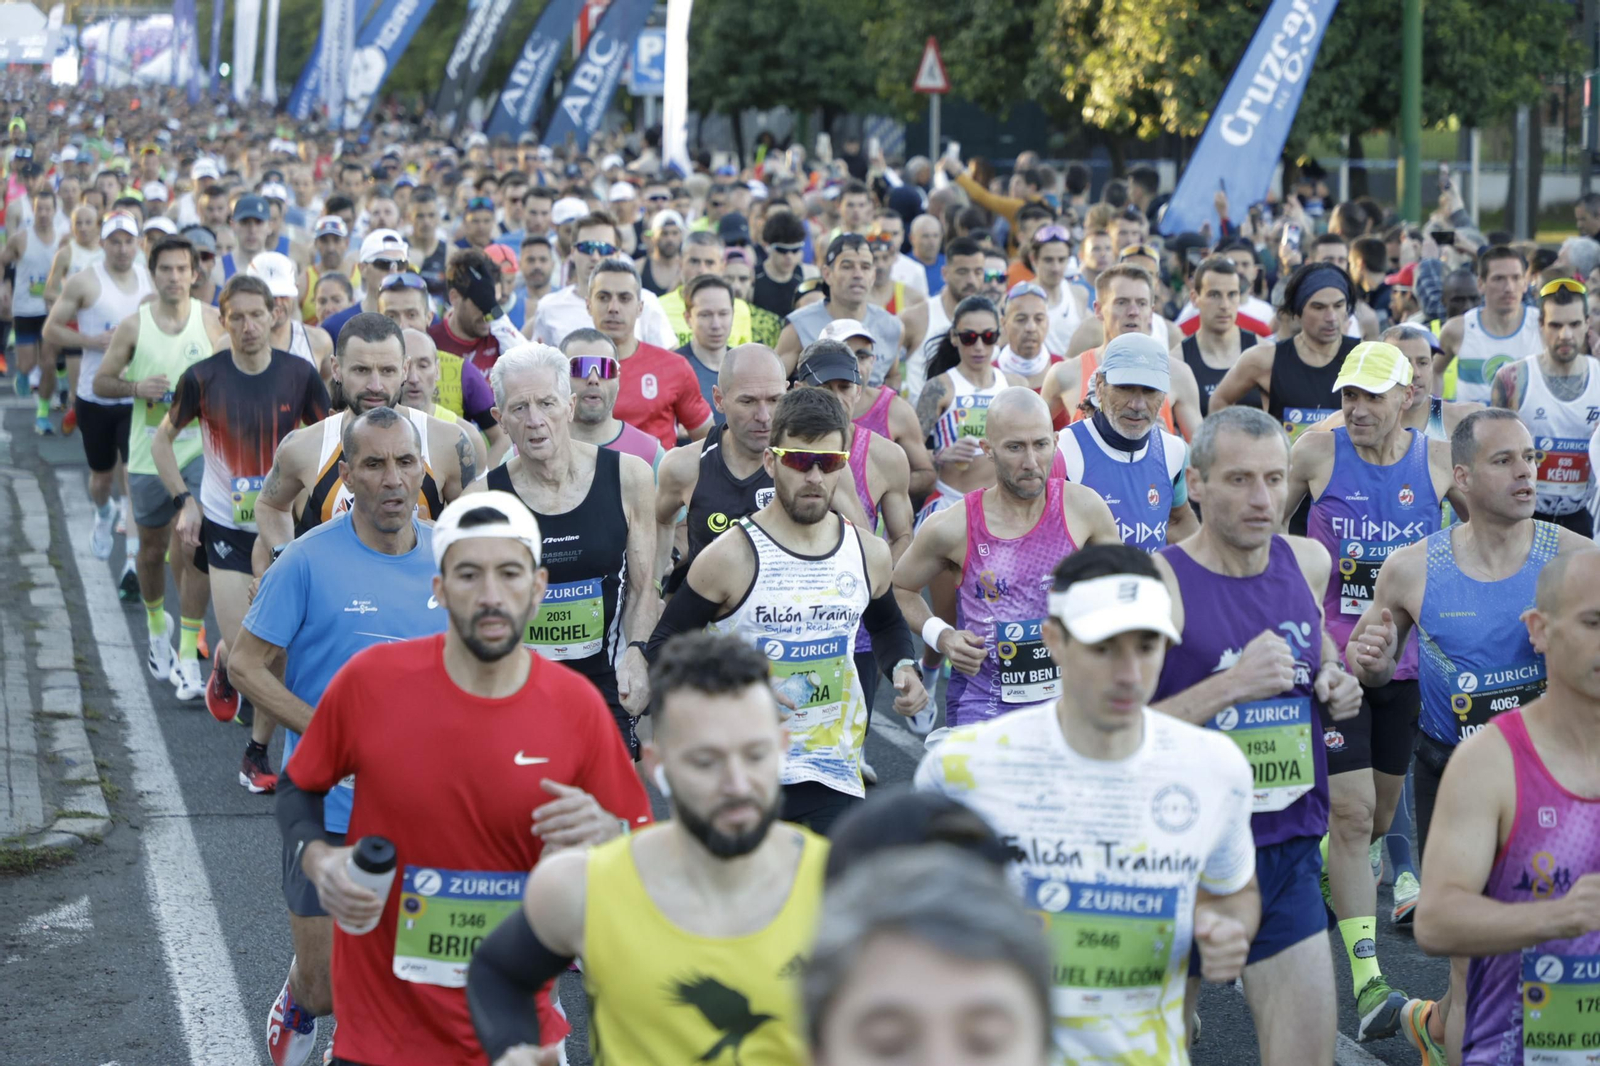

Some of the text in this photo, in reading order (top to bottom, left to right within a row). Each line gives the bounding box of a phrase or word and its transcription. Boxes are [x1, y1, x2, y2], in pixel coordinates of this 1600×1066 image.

[501, 37, 548, 118] ABC
[562, 31, 619, 126] ABC
[1220, 0, 1310, 146] Cruzca
[1547, 466, 1580, 482] KÉVIN
[1332, 514, 1425, 542] FILÍPIDES
[545, 585, 593, 599] ZURICH
[1341, 583, 1368, 598] ANA
[546, 611, 571, 622] 2031
[756, 605, 802, 623] Falcón
[529, 624, 590, 641] MICHEL
[790, 642, 838, 658] ZURICH
[1001, 672, 1025, 684] GUY
[1029, 667, 1053, 682] BEN
[1484, 664, 1539, 686] ZURICH
[1490, 695, 1520, 712] 4062
[1245, 706, 1299, 724] ZURICH
[1247, 741, 1276, 755] 1934
[448, 877, 520, 896] ZURICH
[1078, 888, 1163, 914] ZURICH
[448, 913, 486, 929] 1346
[1525, 1032, 1576, 1048] ASSAF
